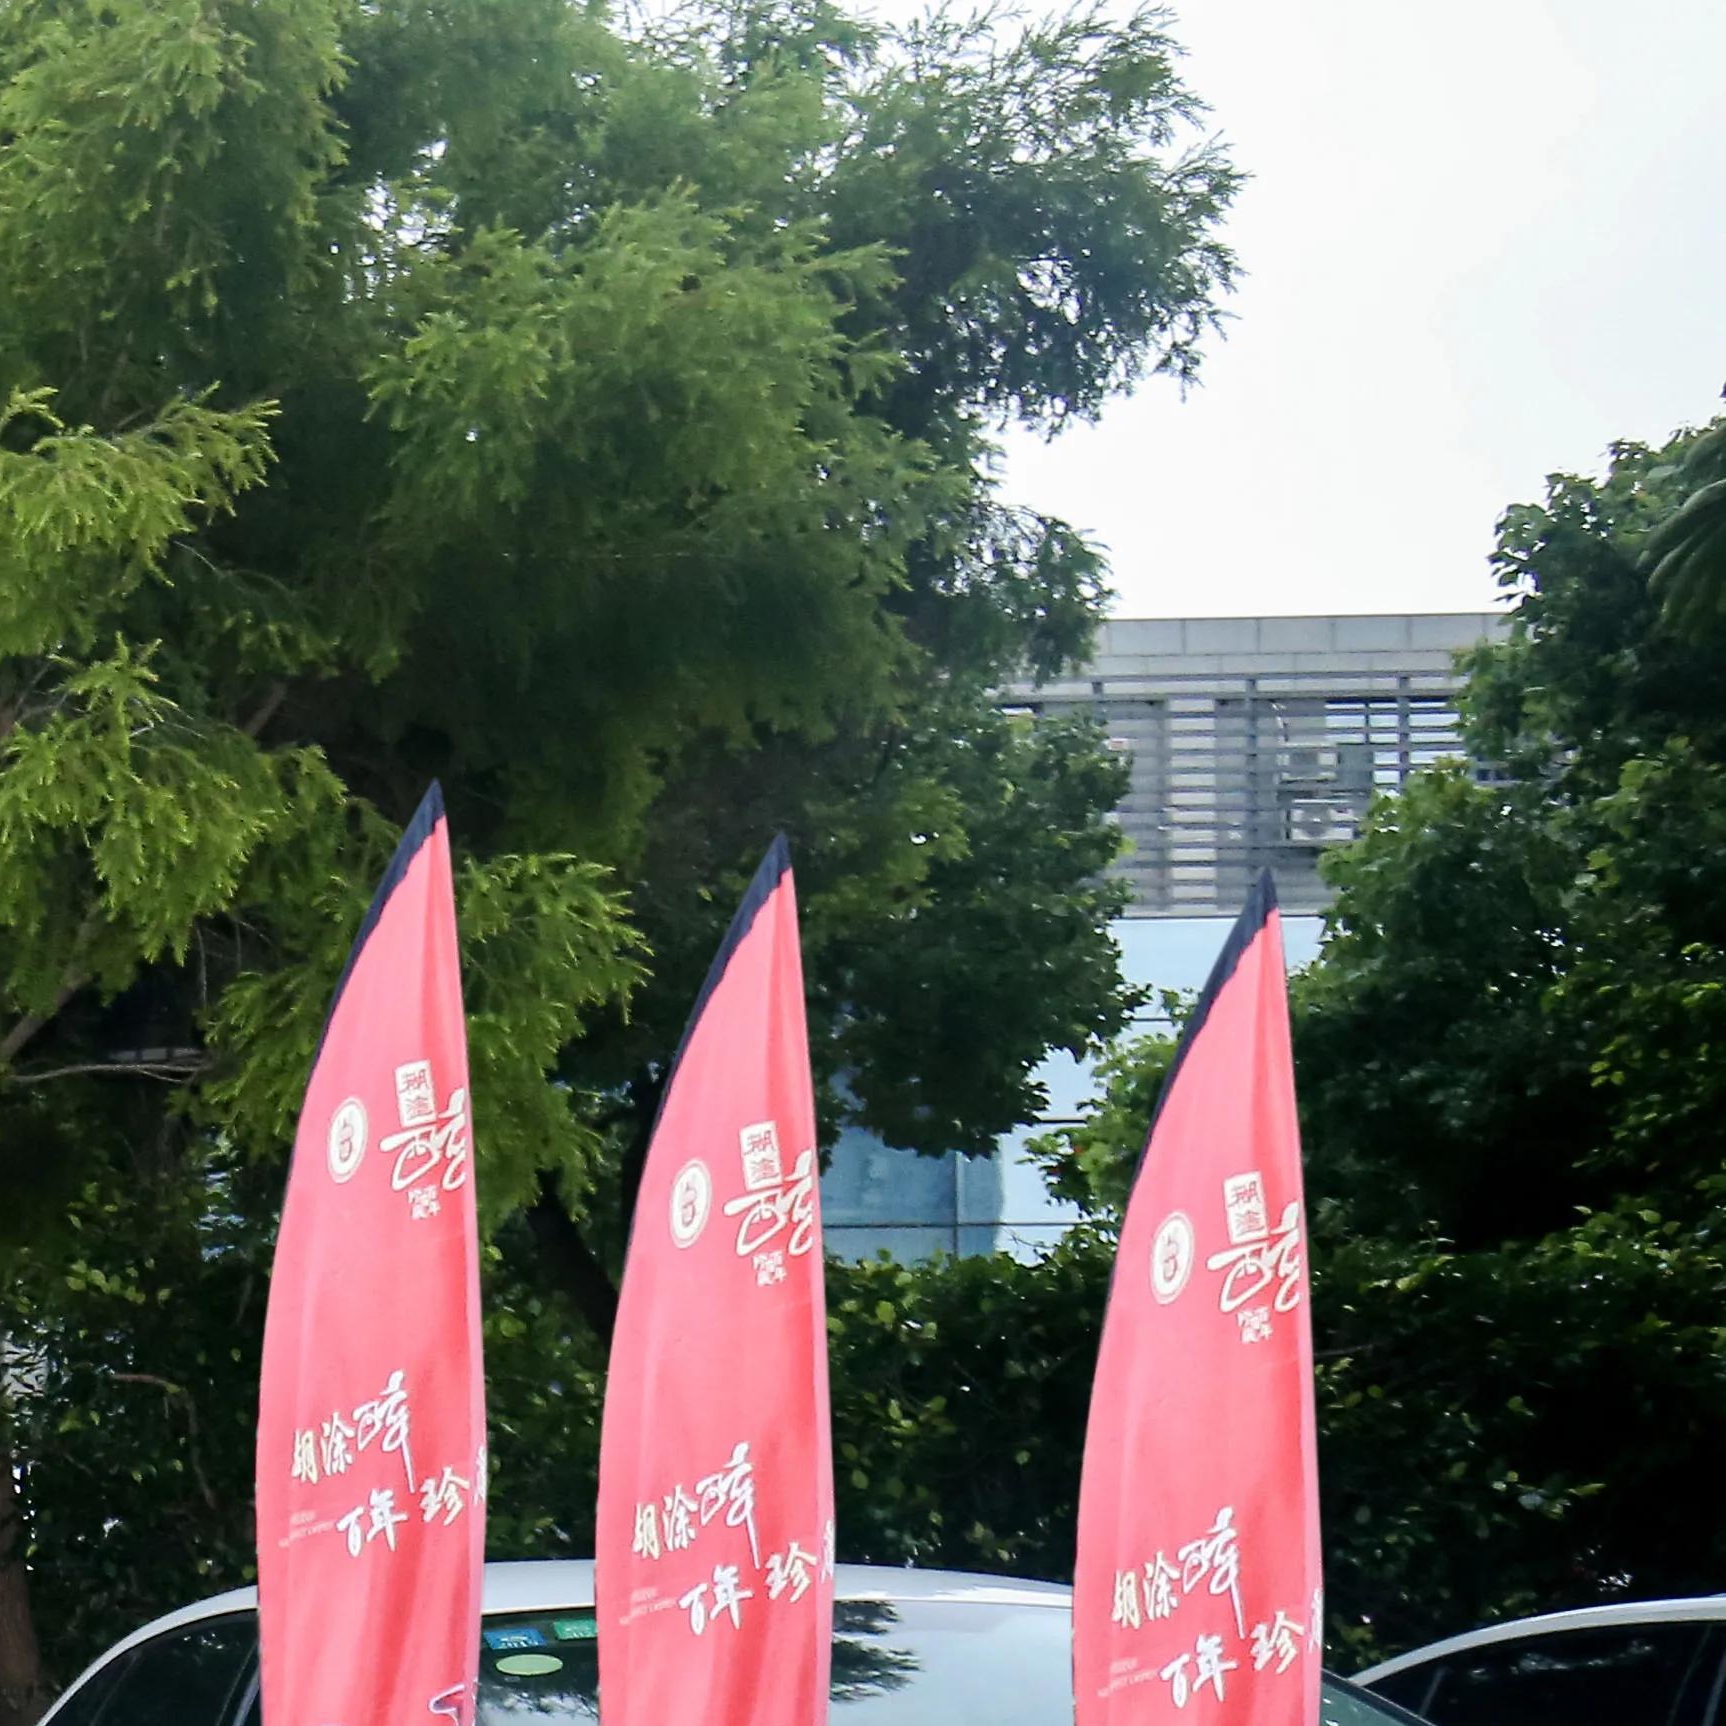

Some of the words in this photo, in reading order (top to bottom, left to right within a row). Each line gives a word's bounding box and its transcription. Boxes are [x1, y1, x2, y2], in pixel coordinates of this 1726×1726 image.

[337, 1446, 487, 1557] 百年珍
[679, 1520, 834, 1635] 百年珍
[1161, 1588, 1322, 1708] 百年珍
